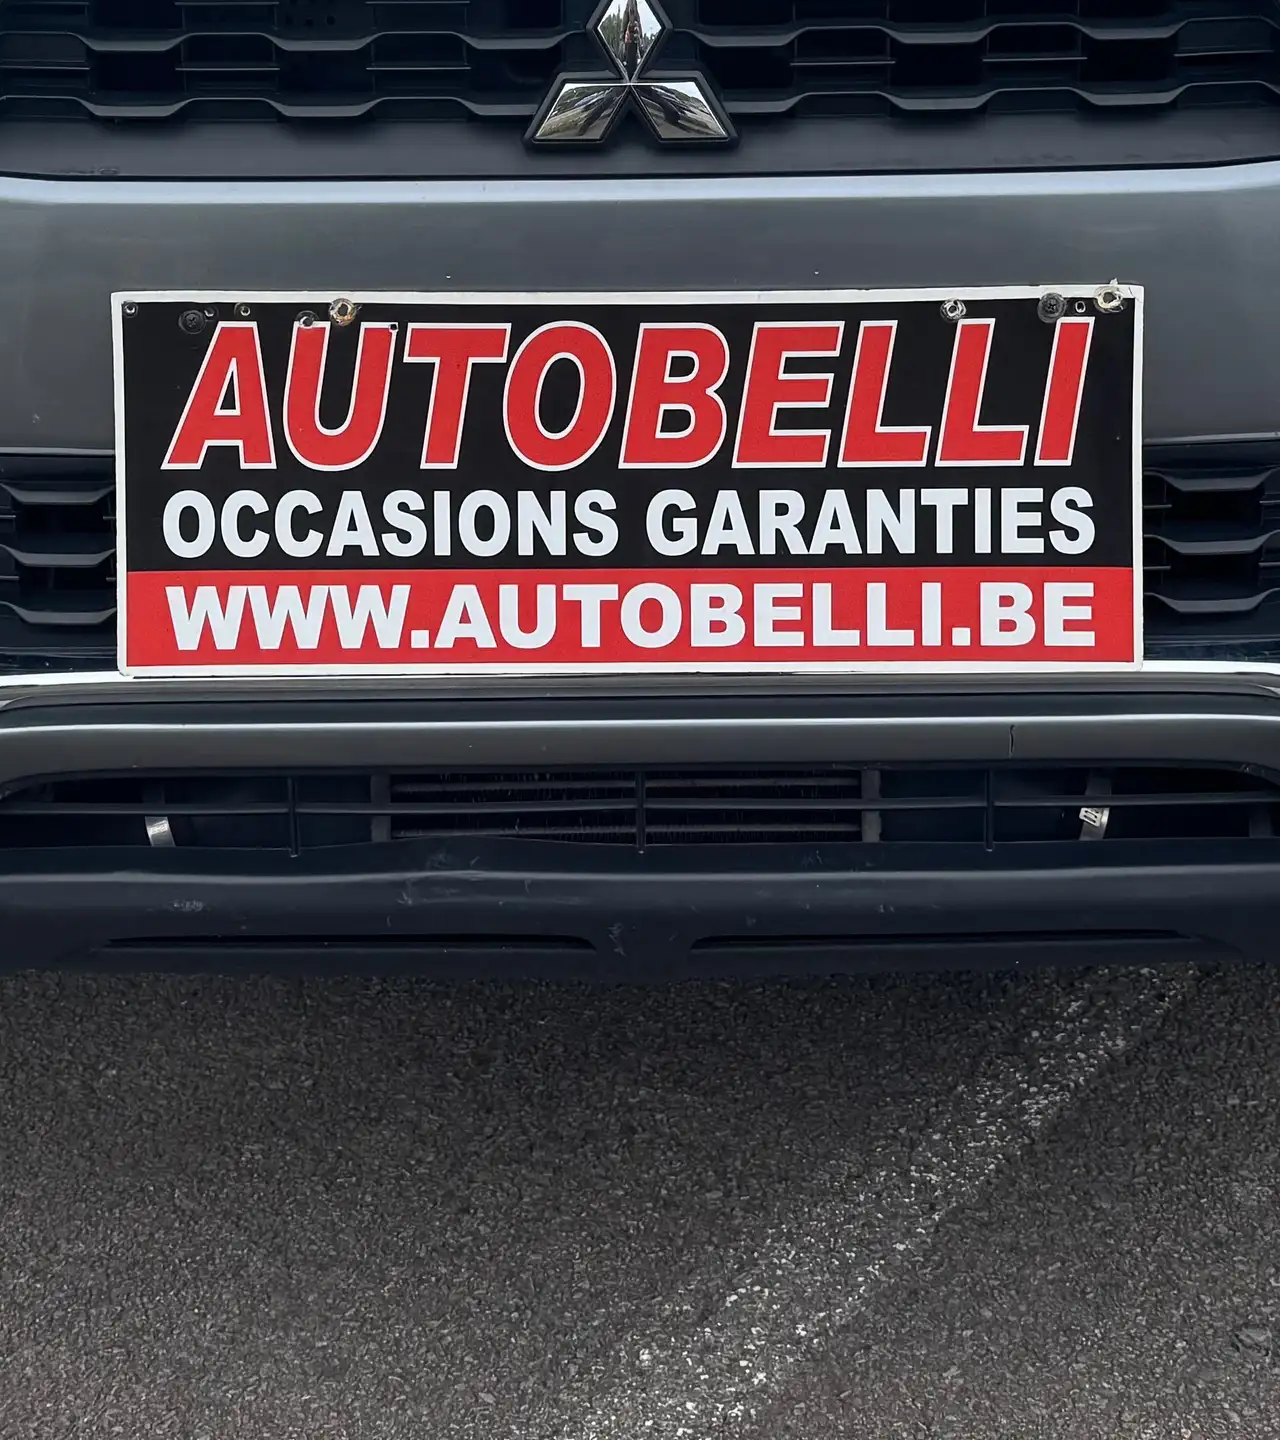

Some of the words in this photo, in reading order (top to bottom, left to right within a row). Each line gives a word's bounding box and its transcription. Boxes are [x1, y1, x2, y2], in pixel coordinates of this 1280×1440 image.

[161, 318, 1096, 471] AUTOBELLI
[162, 489, 620, 559] OCCASIONS
[646, 486, 1096, 557] GARANTIES
[164, 581, 1096, 651] WWW.AUTOBELLI.BE
